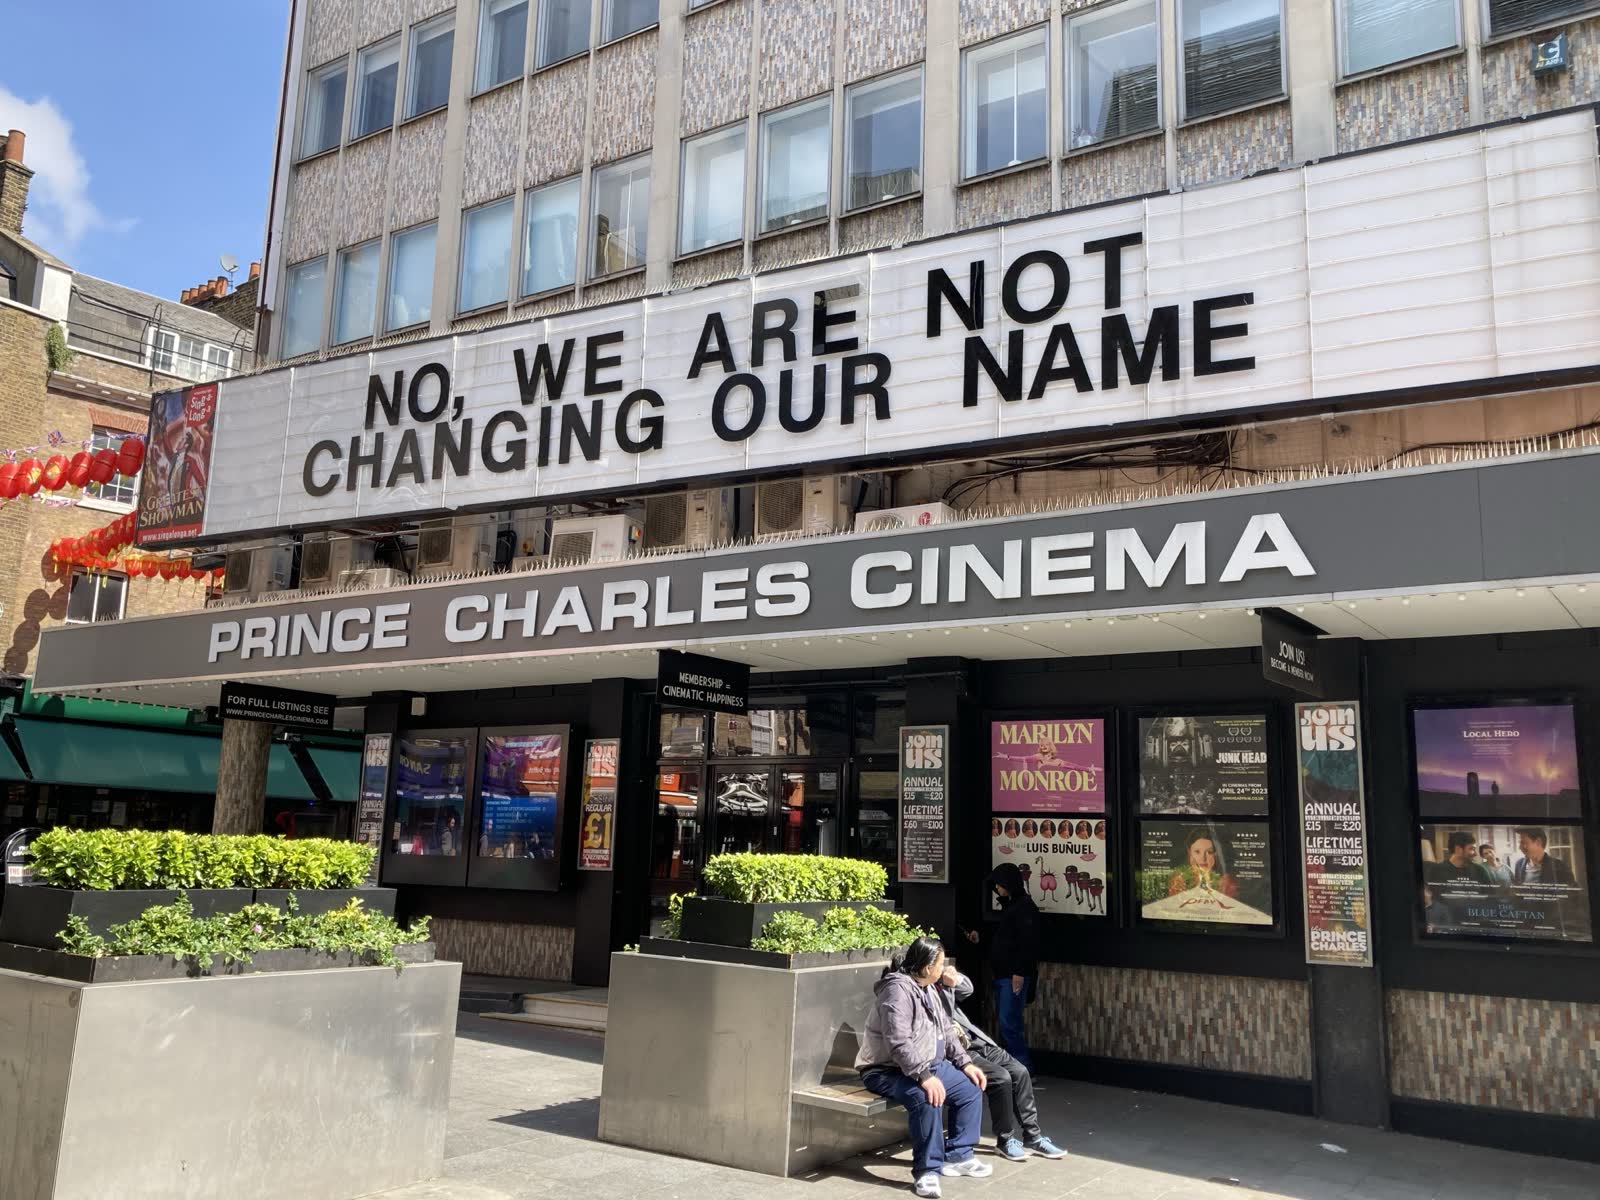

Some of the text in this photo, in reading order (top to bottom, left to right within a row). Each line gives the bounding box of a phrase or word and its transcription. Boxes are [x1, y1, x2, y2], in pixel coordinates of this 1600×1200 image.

[365, 232, 1143, 430] NO, WE ARE NOT
[302, 292, 1256, 497] CHANGING OUR NAME
[140, 501, 203, 527] SHOWMAN
[208, 512, 1317, 663] PRINCE CHARLES CINEMA
[1279, 640, 1306, 666] JOIN US!
[679, 672, 724, 689] MEMBERSHIP
[1304, 671, 1314, 683] NOW
[662, 685, 744, 707] CINEMATIC HAPPINESS
[227, 695, 329, 715] FOR FULL LISTINGS SEE
[226, 708, 329, 725] WWW.PRINCECHARLESCINEMA.COM
[1000, 723, 1094, 745] MARILYN
[1216, 752, 1268, 763] JUNK HEAD
[904, 777, 943, 787] ANNUAL
[1000, 770, 1097, 792] MONROE
[903, 792, 916, 800] £15
[929, 792, 944, 800] £20
[585, 803, 613, 812] REGULAR
[903, 805, 944, 815] LIFETIME
[1304, 803, 1361, 815] ANNUAL
[583, 812, 612, 849] £1
[903, 820, 918, 829] £60
[927, 821, 944, 829] £100
[1305, 821, 1322, 832] £15
[1342, 821, 1362, 831] £20
[1026, 842, 1049, 853] LUIS
[1052, 841, 1094, 855] BUÑUEL
[1306, 836, 1362, 849] LIFETIME
[1306, 855, 1326, 865] £60
[1341, 856, 1363, 866] £100
[1468, 908, 1545, 920] BLUE CAFTAN
[1310, 930, 1367, 943] PRINCE
[1310, 941, 1367, 952] CHARLES
